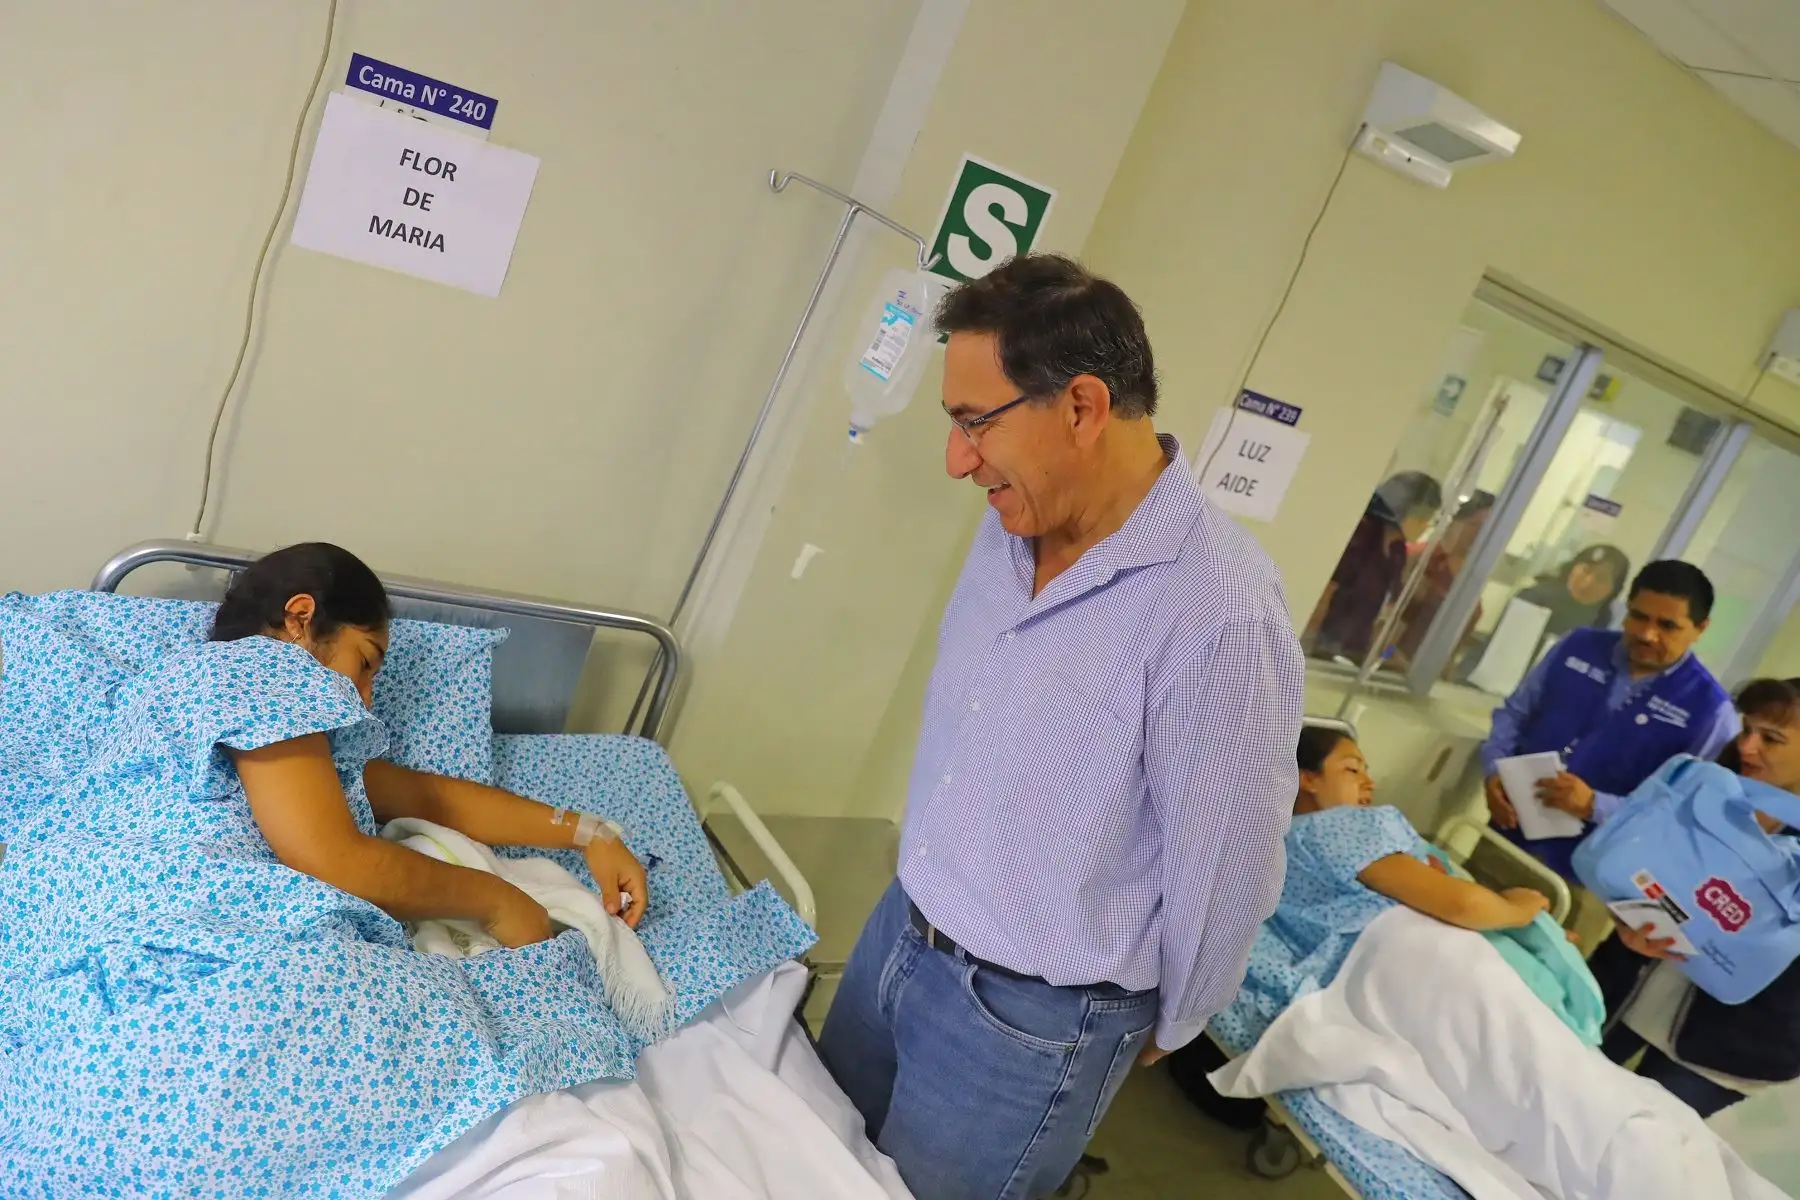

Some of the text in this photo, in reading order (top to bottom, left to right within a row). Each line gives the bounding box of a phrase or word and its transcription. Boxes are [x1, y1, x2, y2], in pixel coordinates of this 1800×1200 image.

[358, 65, 415, 98] Cama
[420, 84, 447, 106] N°
[449, 95, 487, 121] 240
[399, 148, 457, 182] FLOR
[402, 187, 434, 211] DE
[368, 215, 445, 252] MARIA
[947, 182, 1029, 280] S
[1238, 439, 1272, 463] LUZ
[1216, 472, 1258, 497] AIDE
[1704, 886, 1745, 924] CRED
